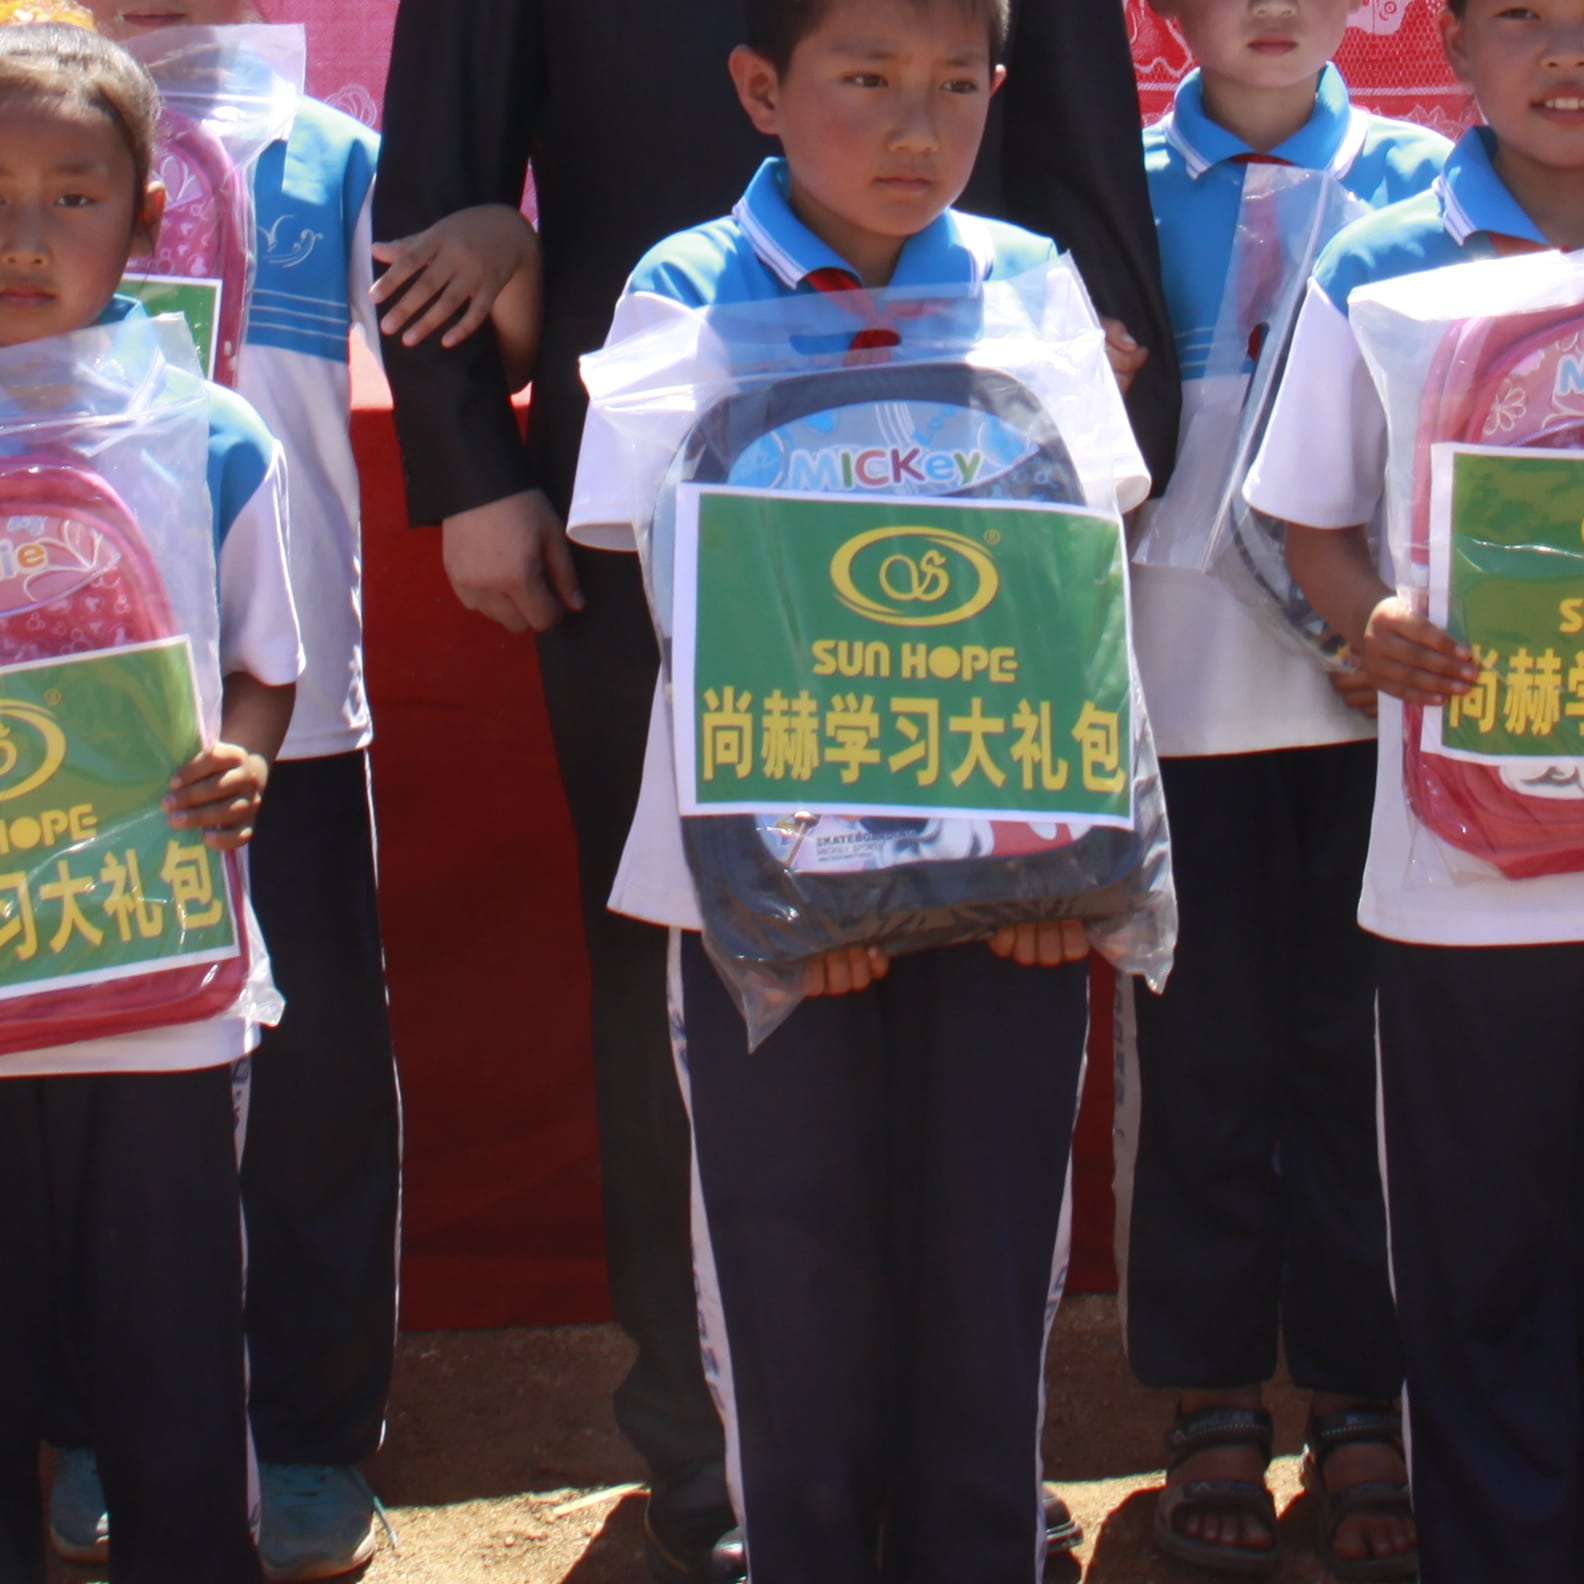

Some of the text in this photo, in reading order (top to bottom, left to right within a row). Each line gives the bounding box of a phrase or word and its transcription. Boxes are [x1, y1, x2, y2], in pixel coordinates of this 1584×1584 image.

[814, 641, 1016, 682] SUN HOPE
[702, 687, 1127, 793] 尚赫学习大礼包
